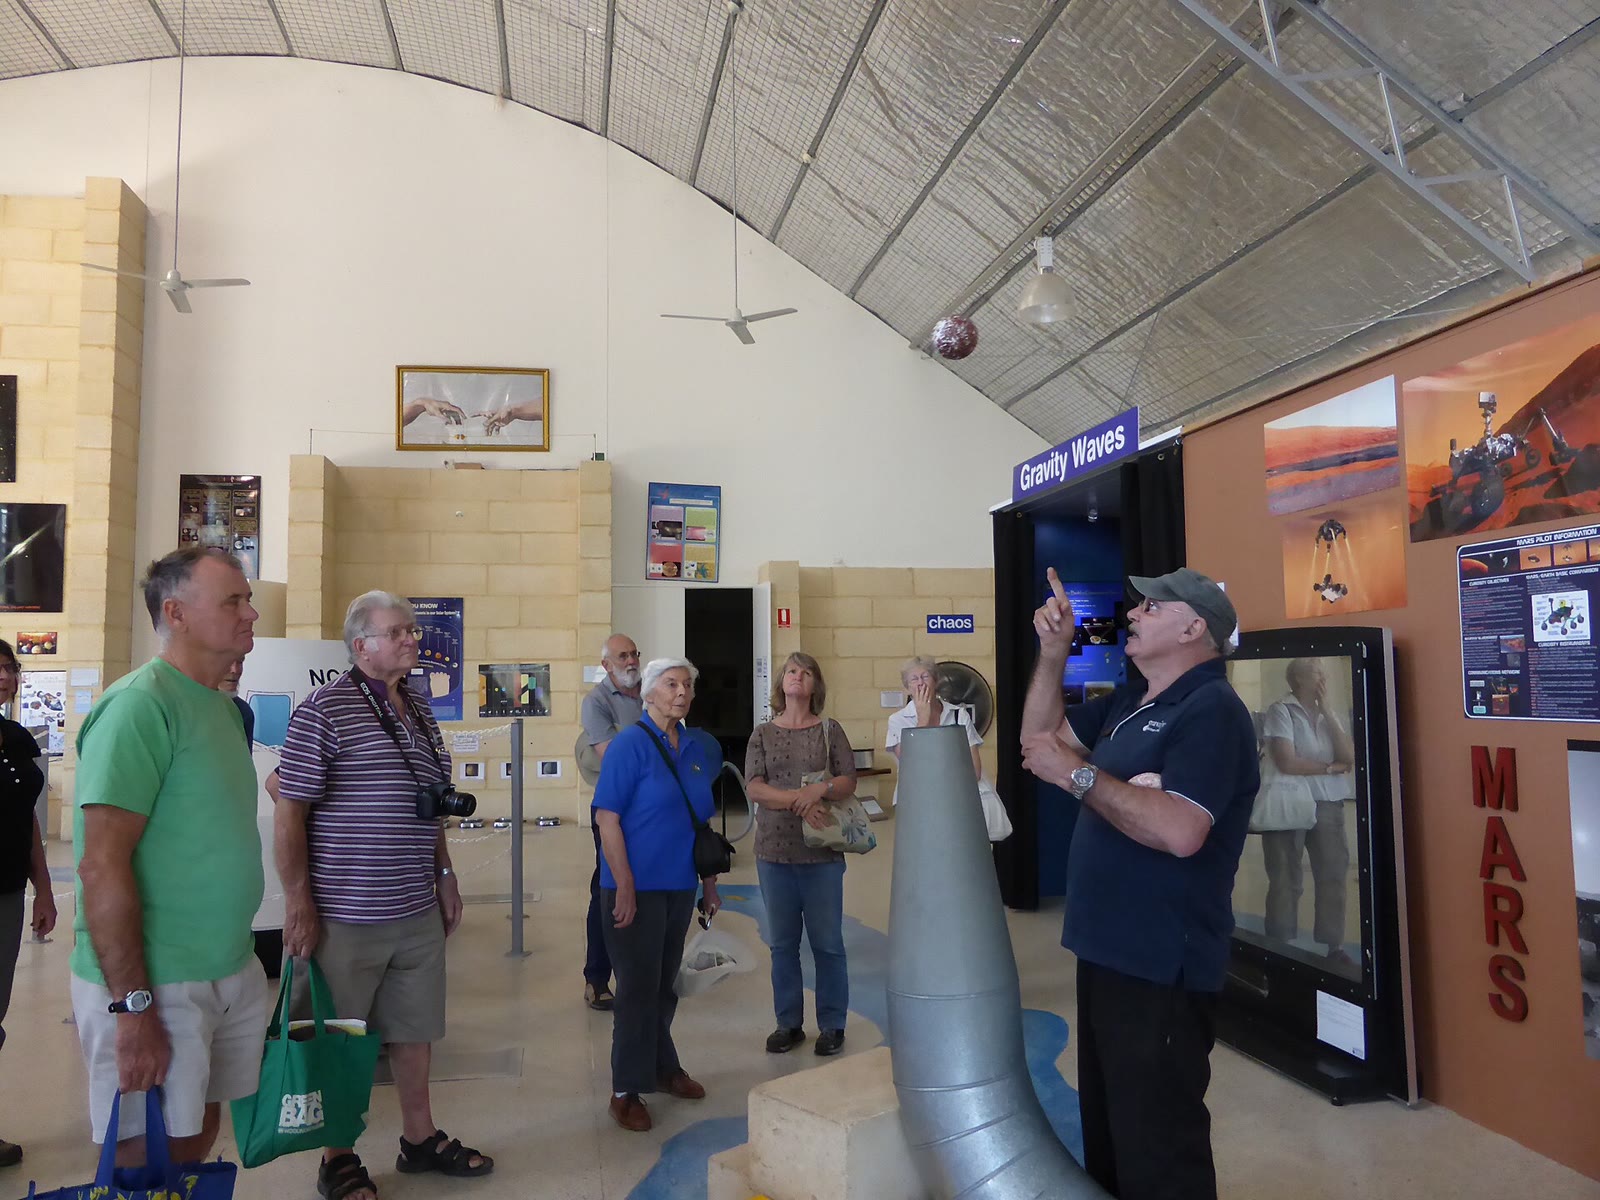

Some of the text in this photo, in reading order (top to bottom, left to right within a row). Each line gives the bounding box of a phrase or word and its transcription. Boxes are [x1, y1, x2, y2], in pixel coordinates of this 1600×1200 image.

[1020, 425, 1125, 491] Gravity Waves
[1516, 528, 1598, 546] MARS PILOT INFORMATION
[928, 615, 972, 629] chaos
[360, 682, 384, 718] EOS DIGITAL
[1471, 745, 1529, 1023] MARS
[281, 1090, 323, 1107] GREEN
[279, 1103, 325, 1128] BAG
